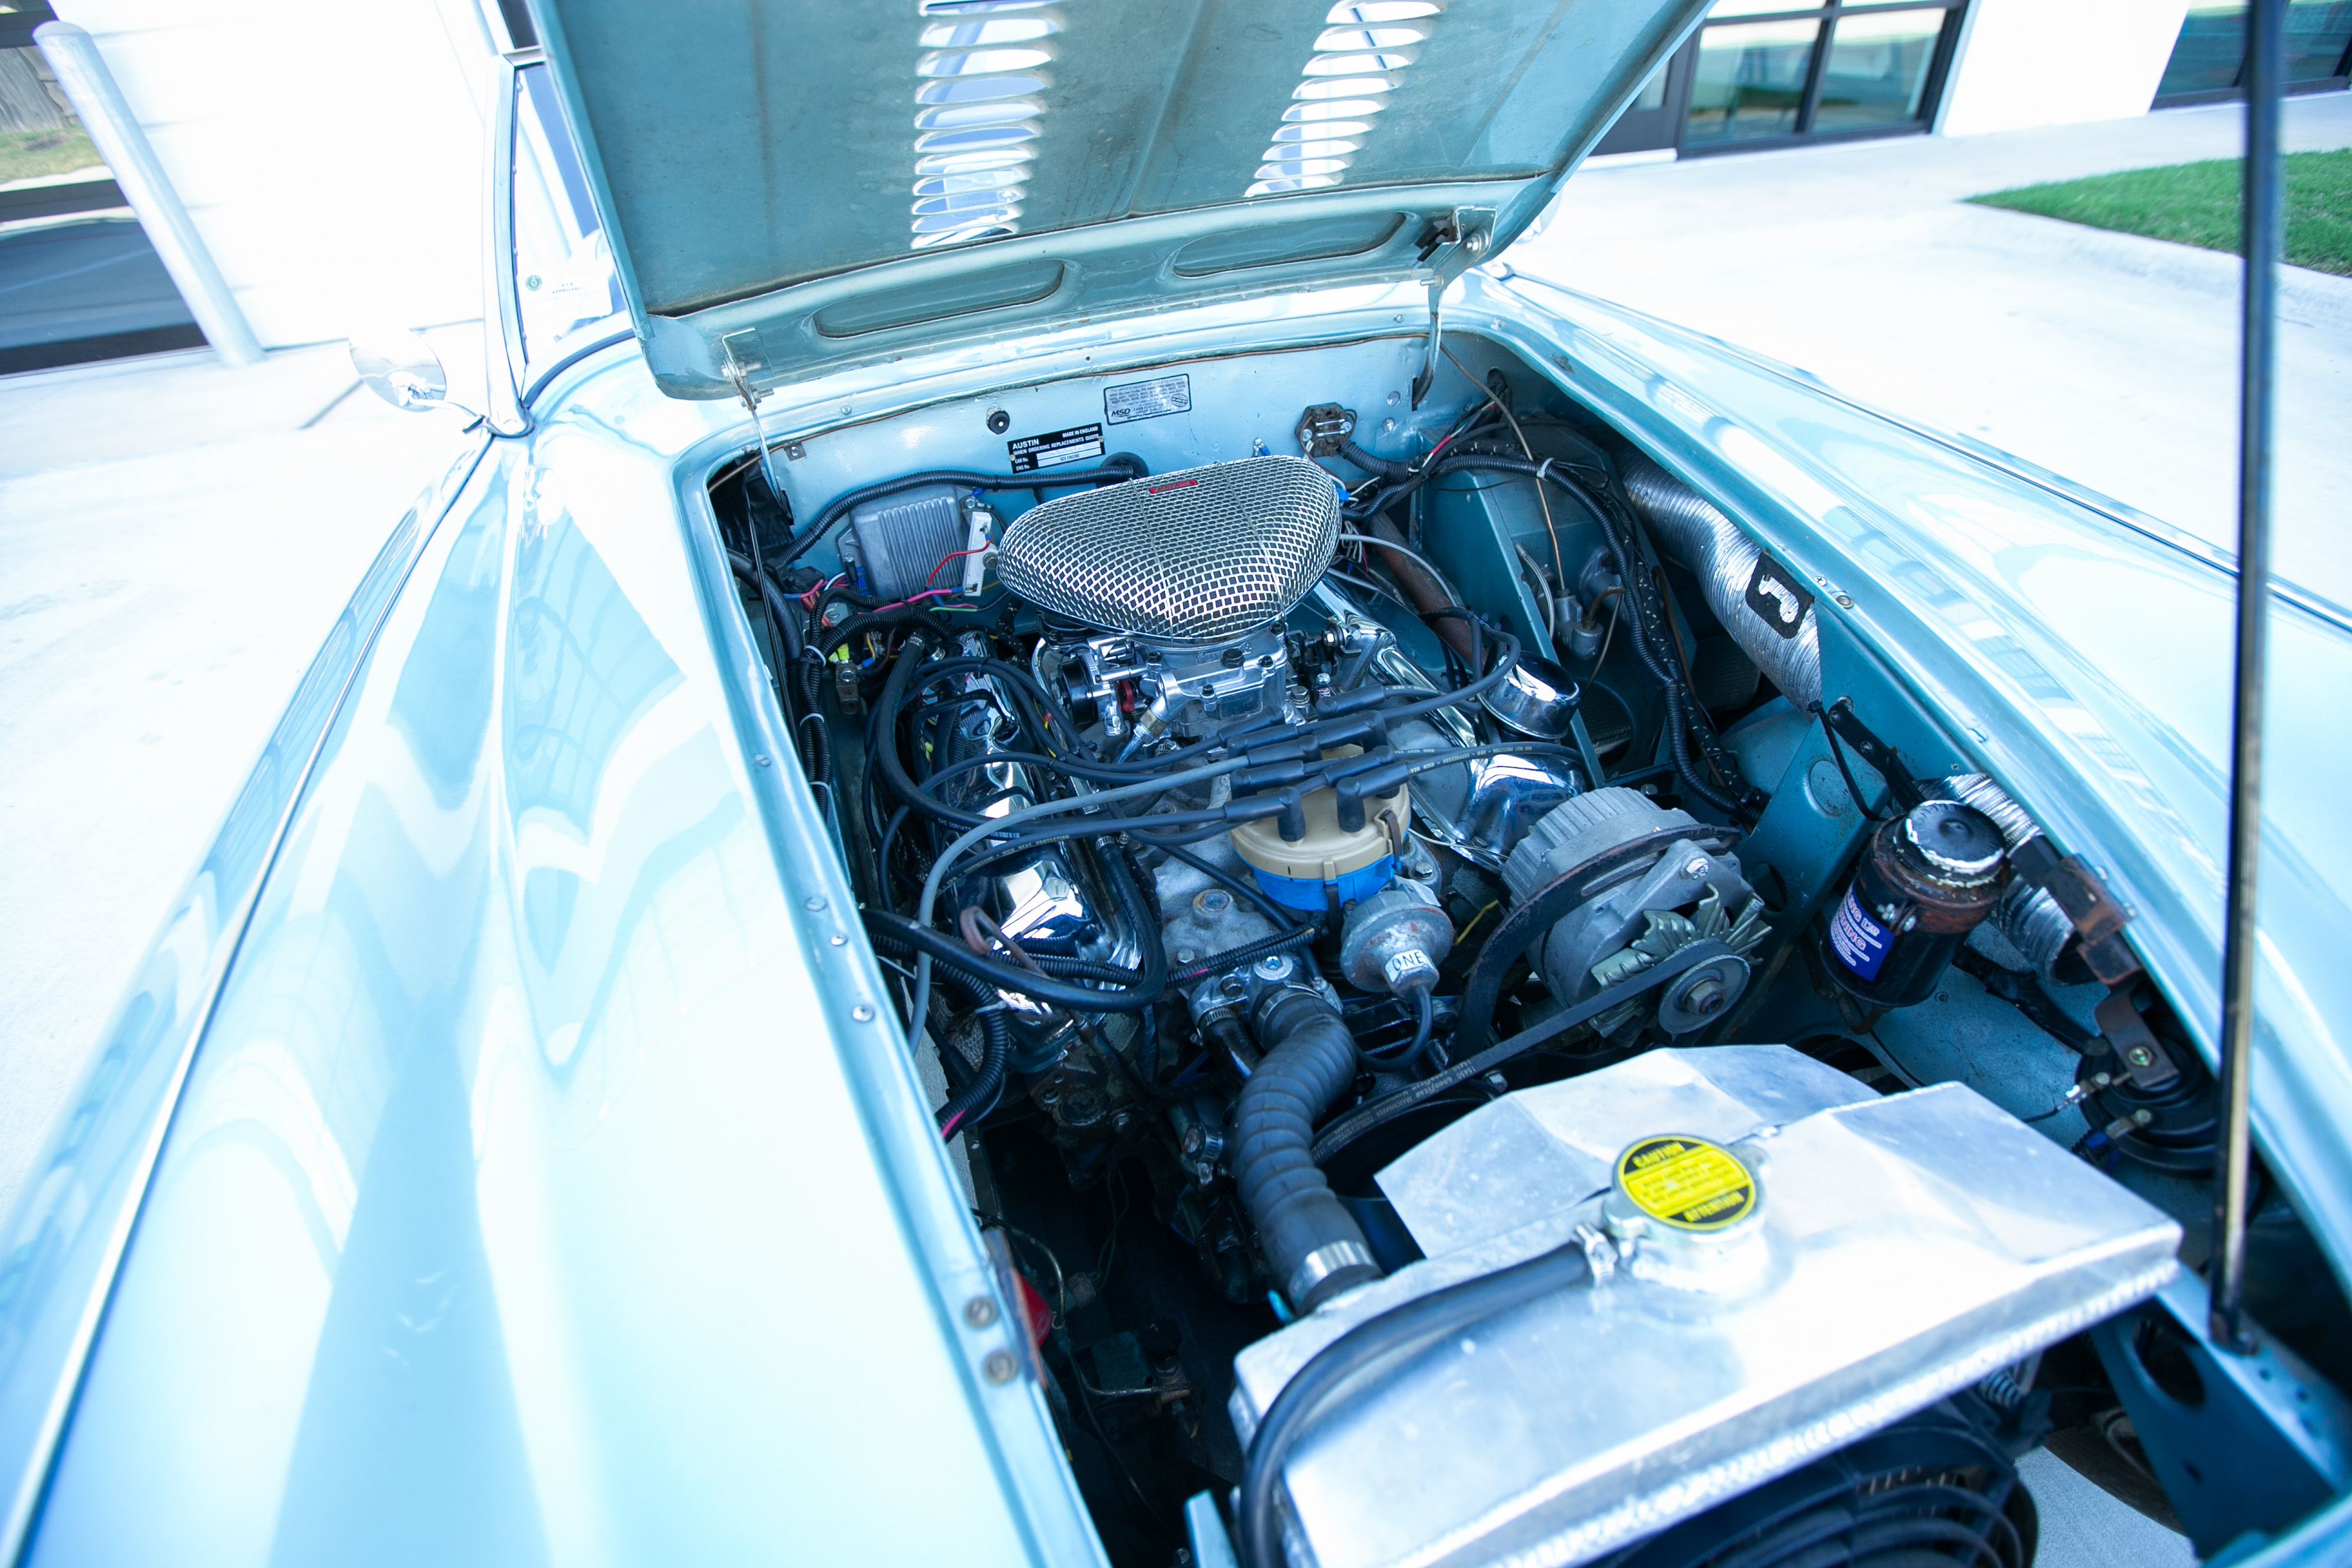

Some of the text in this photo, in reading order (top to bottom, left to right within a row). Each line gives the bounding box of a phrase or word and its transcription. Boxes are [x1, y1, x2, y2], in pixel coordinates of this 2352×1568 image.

[1111, 408, 1131, 417] MSD
[1080, 426, 1099, 434] ENGLAND
[1013, 439, 1039, 450] AUSTIN
[1028, 444, 1050, 453] ORDERING
[1051, 437, 1085, 448] REPLACEMENTS
[937, 817, 948, 826] SAE
[1392, 951, 1424, 972] ONE
[1376, 1066, 1477, 1118] 15450 GOODYEAR MATCHMAKER
[1632, 1141, 1685, 1169] CAUTION
